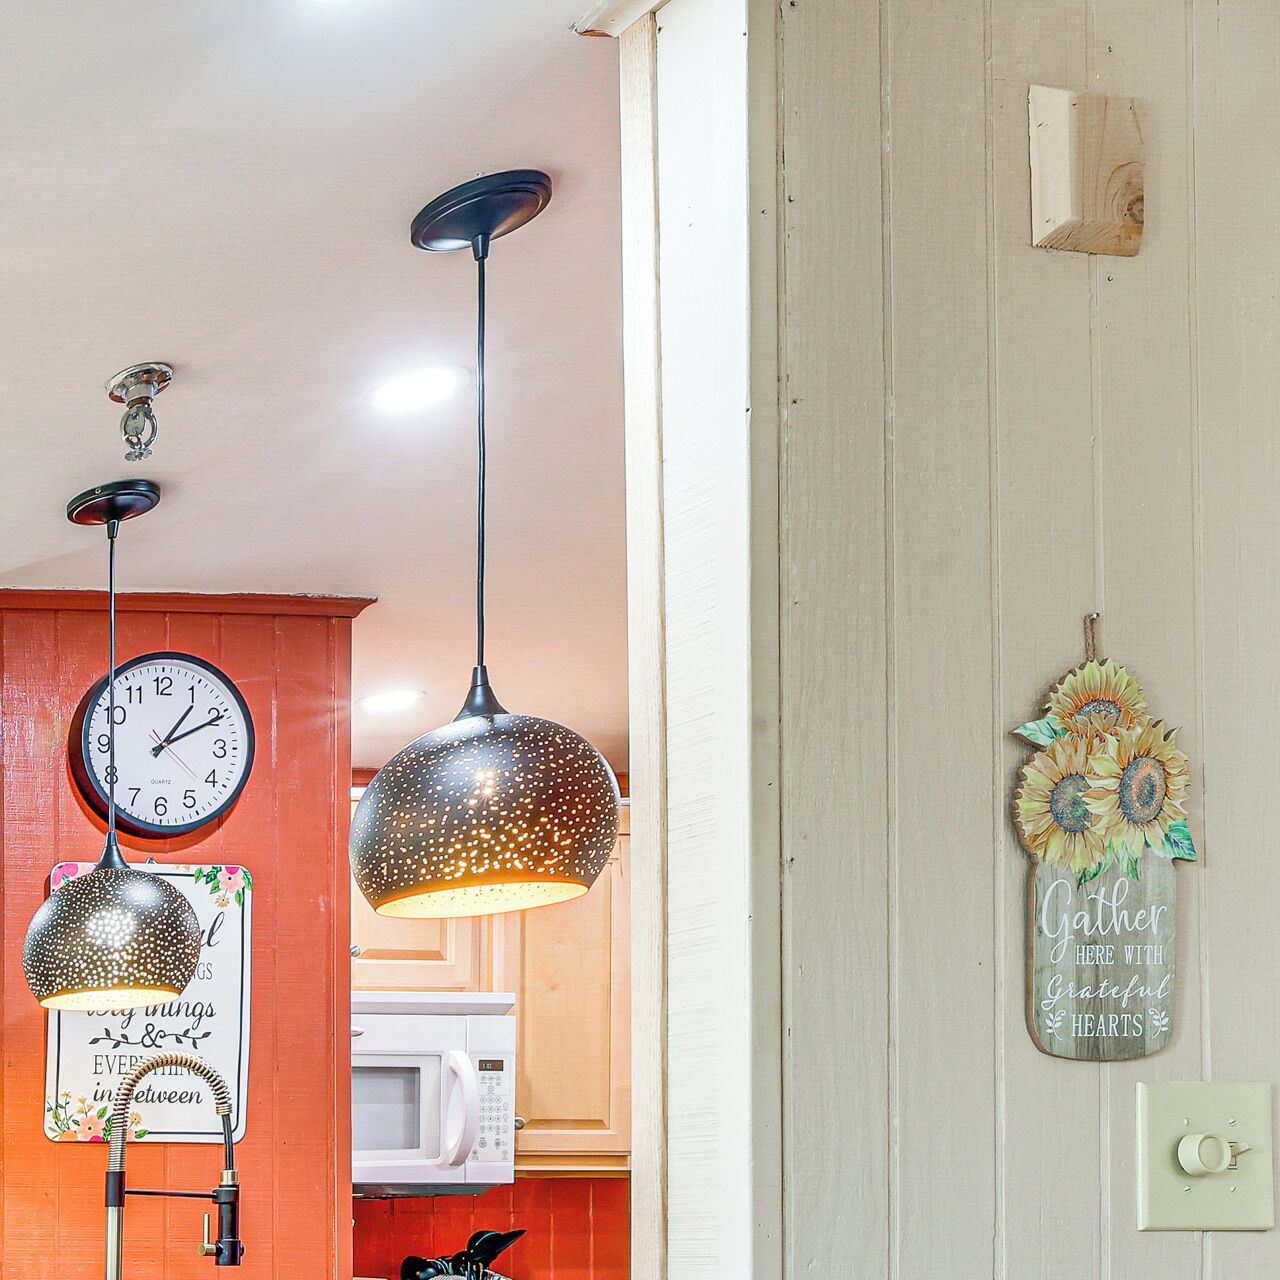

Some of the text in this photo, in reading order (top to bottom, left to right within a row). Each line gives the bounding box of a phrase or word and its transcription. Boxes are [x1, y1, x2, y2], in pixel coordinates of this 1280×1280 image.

[125, 685, 143, 704] 11
[153, 676, 173, 696] 12
[187, 685, 195, 704] 1
[103, 705, 127, 725] 10
[207, 707, 220, 727] 2
[97, 733, 111, 754] 9
[212, 739, 227, 759] 3
[104, 765, 119, 784] 8
[204, 768, 219, 788] 4
[128, 787, 141, 807] 7
[154, 796, 168, 817] 6
[182, 789, 196, 809] 5
[1041, 877, 1168, 964] Gather
[1075, 945, 1163, 965] HERE WITH
[1041, 974, 1169, 1011] Grateful
[1071, 1014, 1143, 1037] HEARTS
[93, 1082, 203, 1104] in etween
